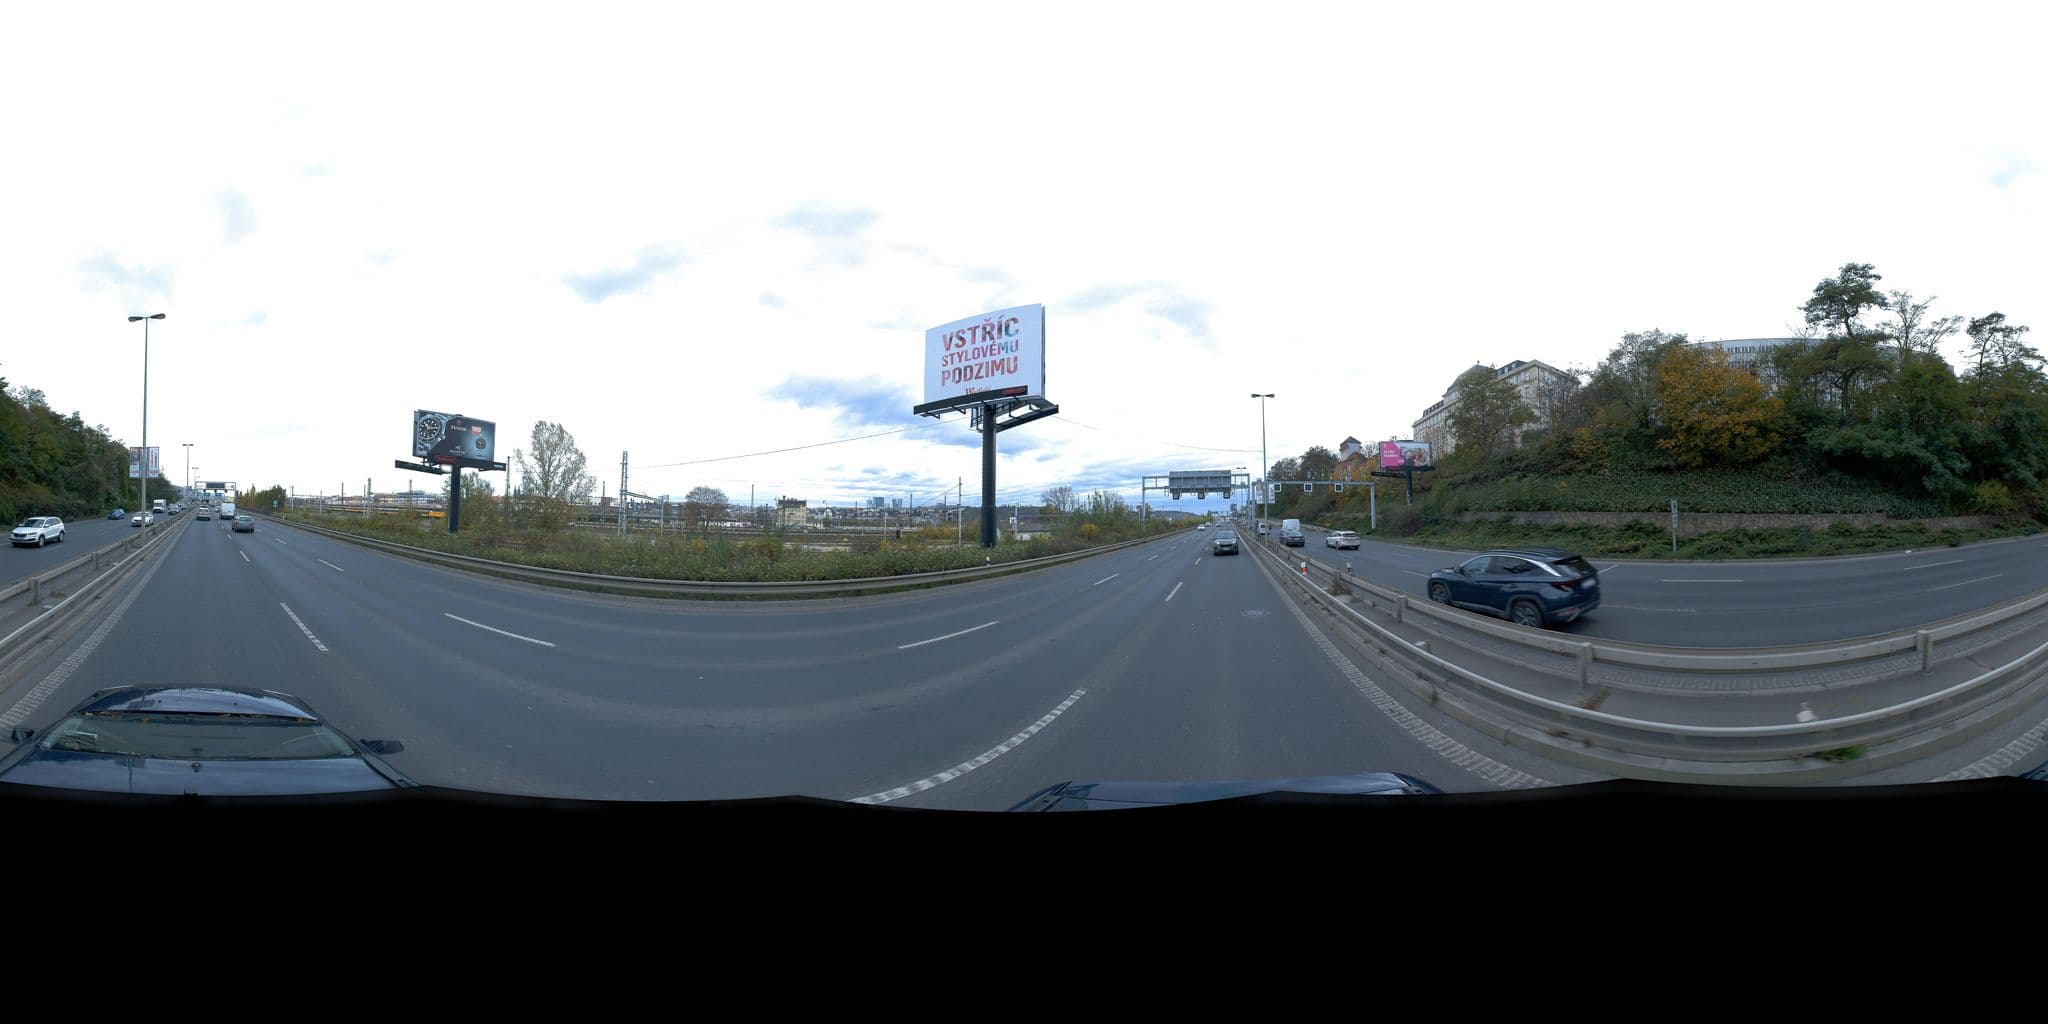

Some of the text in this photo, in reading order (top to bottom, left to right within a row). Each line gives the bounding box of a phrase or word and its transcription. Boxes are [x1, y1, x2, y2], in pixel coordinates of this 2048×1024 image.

[942, 315, 1020, 352] VSTŘÍC
[941, 339, 1019, 367] STYLOVÉMU
[941, 355, 1018, 387] PODZIMU
